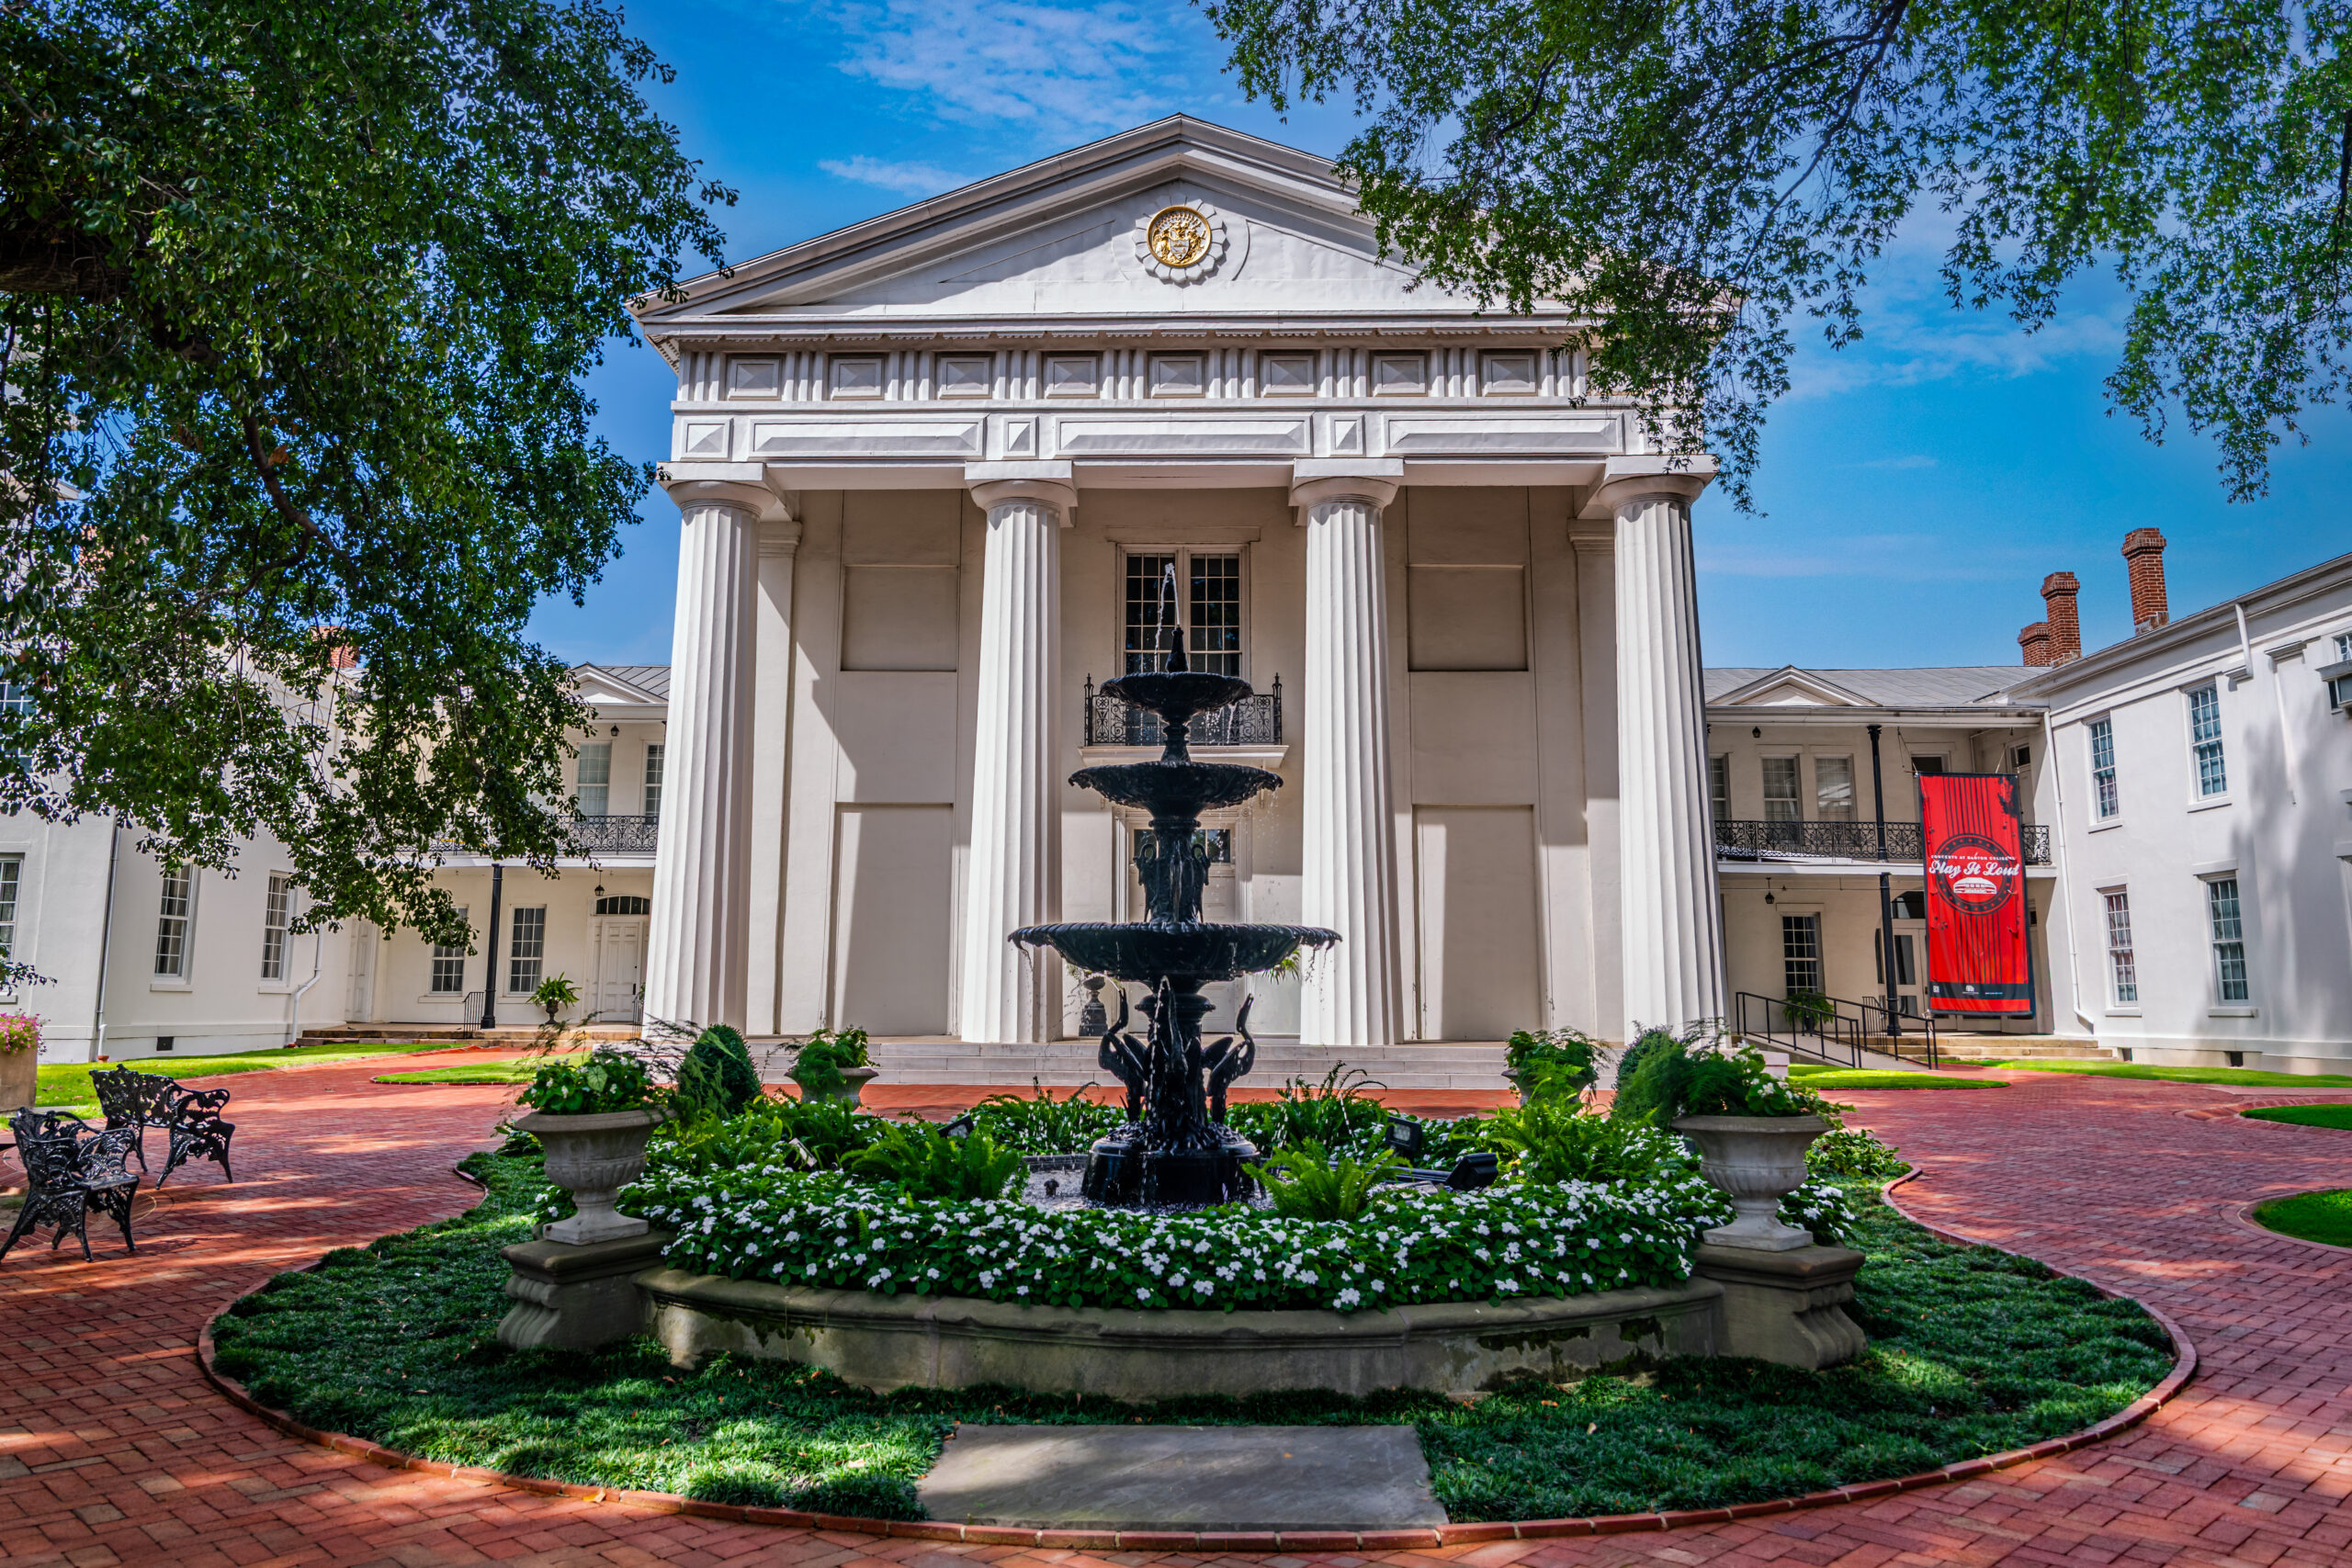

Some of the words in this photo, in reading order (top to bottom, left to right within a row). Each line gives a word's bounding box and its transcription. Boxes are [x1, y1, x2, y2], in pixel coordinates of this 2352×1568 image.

[1928, 860, 1962, 879] Play
[1963, 862, 1981, 875] It
[1983, 862, 2020, 875] Loud
